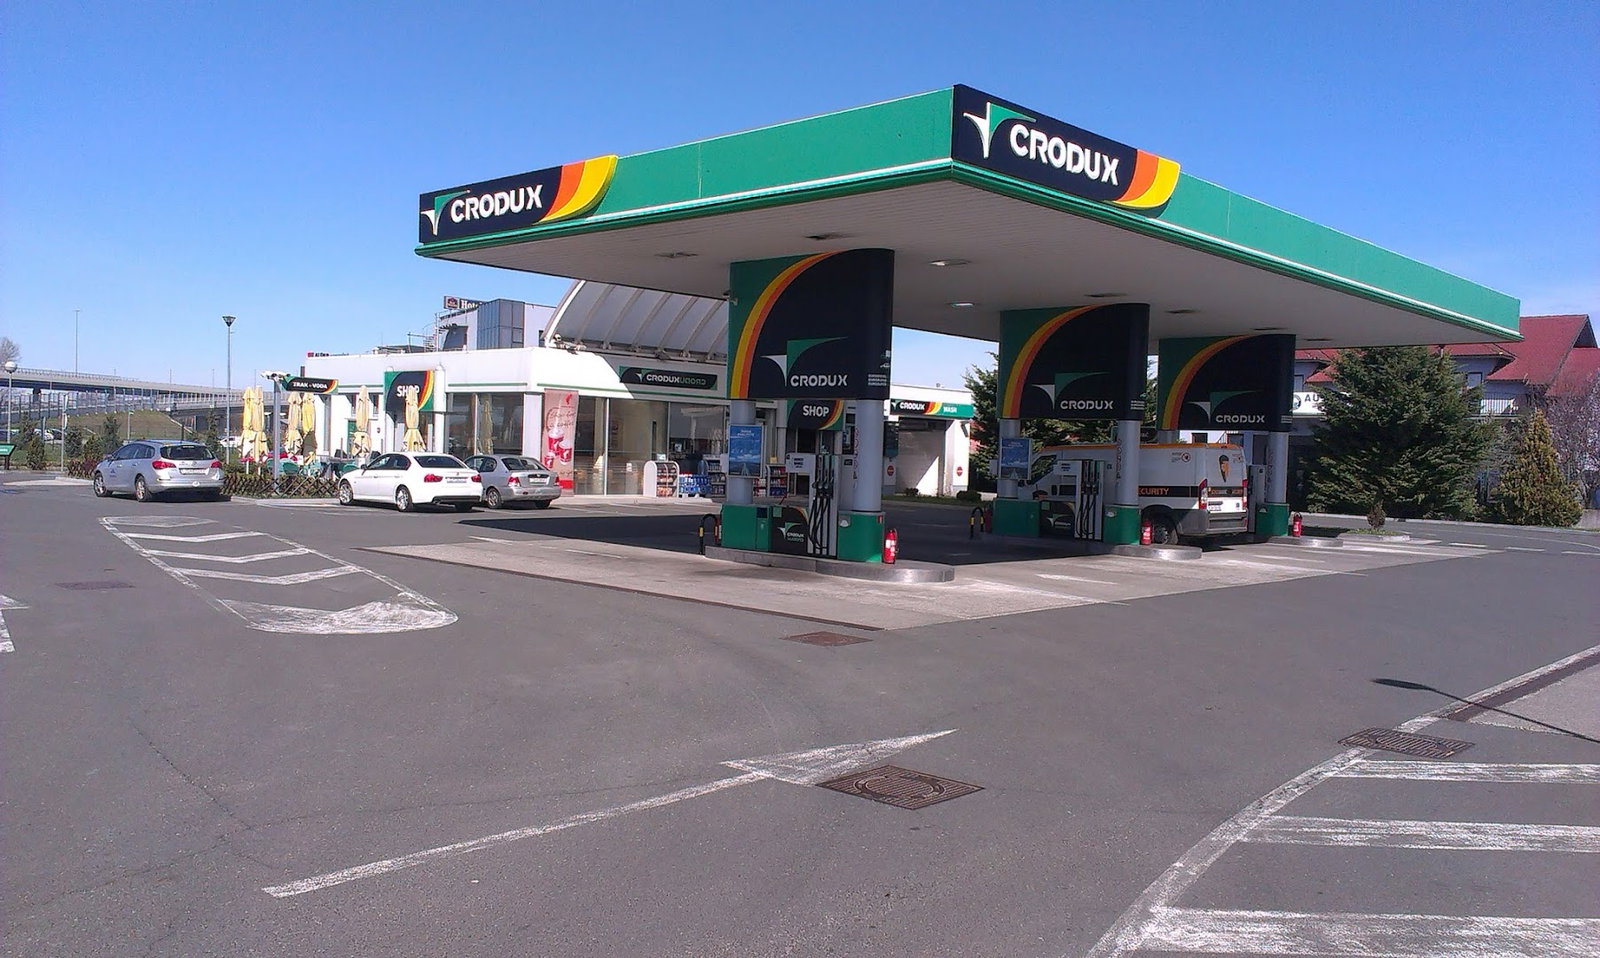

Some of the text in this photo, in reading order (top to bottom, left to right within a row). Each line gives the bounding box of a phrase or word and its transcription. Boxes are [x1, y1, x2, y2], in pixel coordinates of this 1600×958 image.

[1010, 124, 1119, 186] CRODUX
[451, 184, 543, 223] CRODUX
[460, 299, 483, 309] Hot
[646, 373, 680, 384] CRODUX
[790, 373, 848, 387] CRODUX
[899, 402, 926, 411] CRODUX
[1060, 400, 1114, 410] CRODUX
[802, 405, 830, 417] SHOP
[1215, 414, 1265, 423] CRODUX
